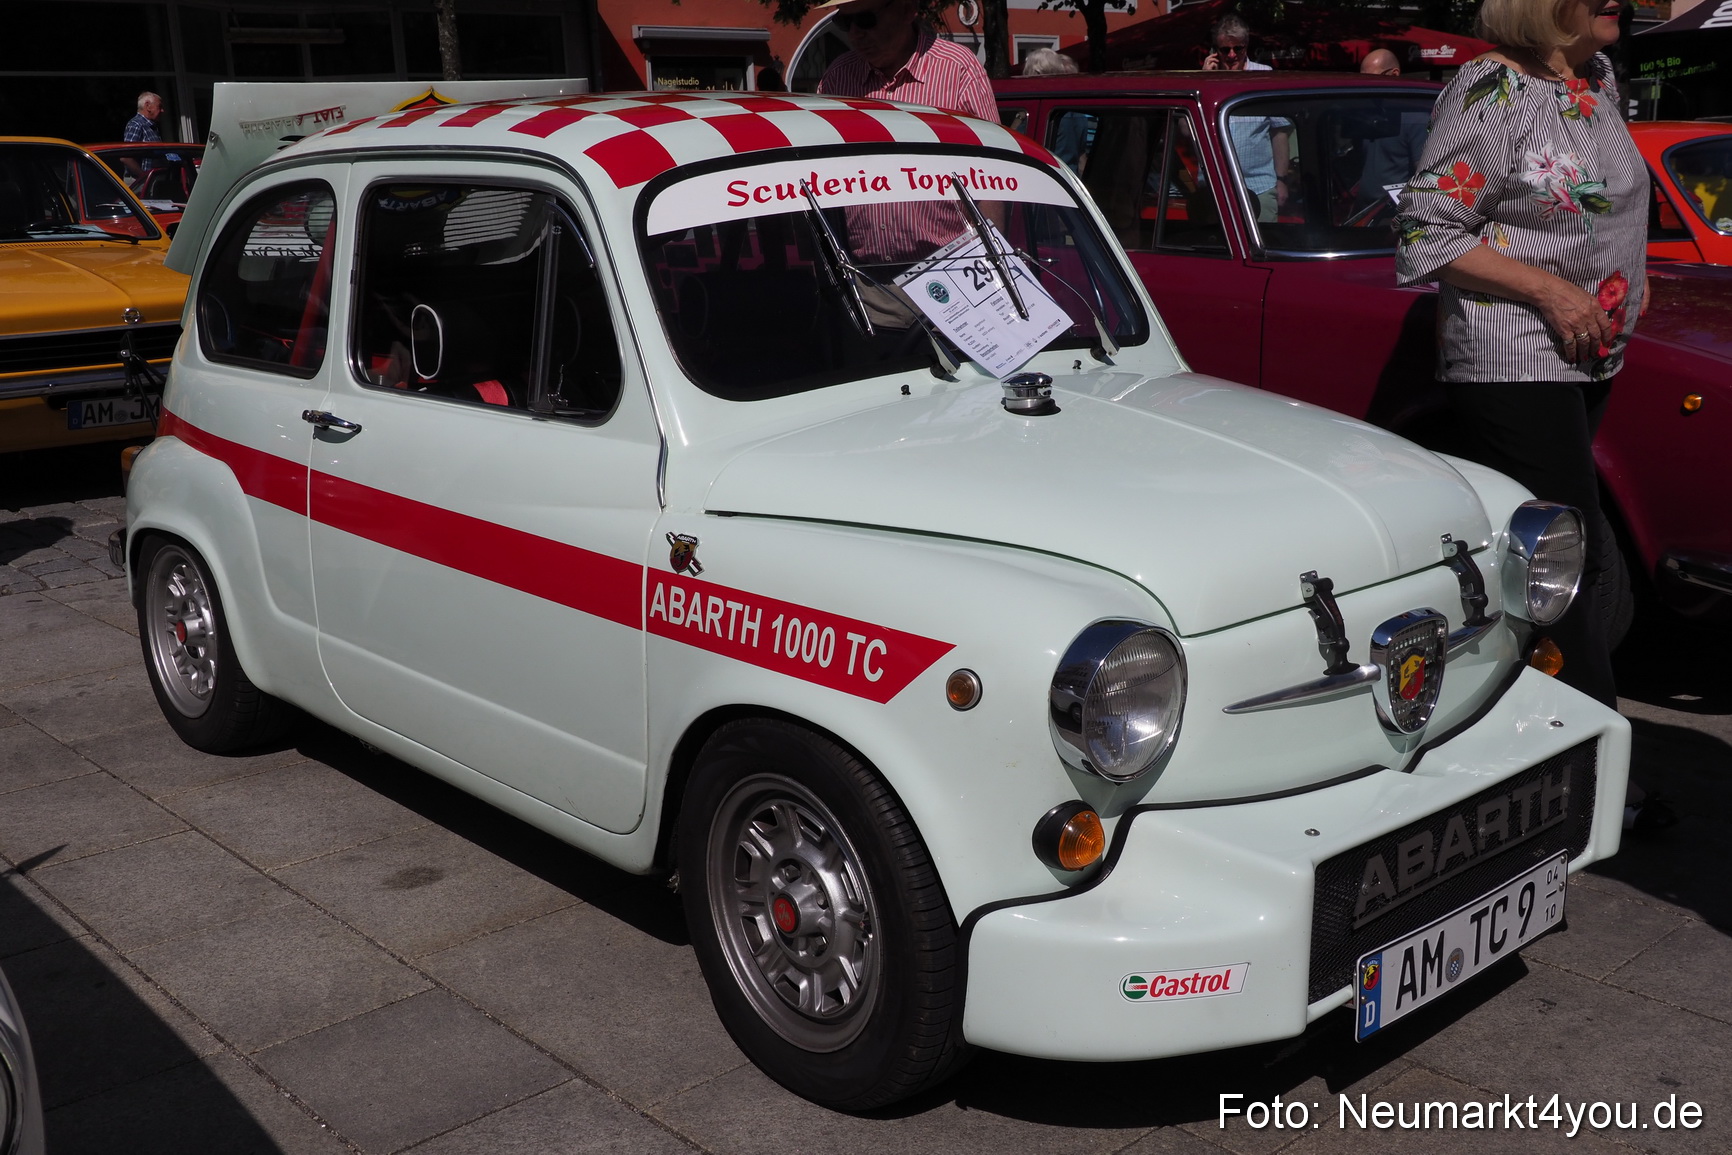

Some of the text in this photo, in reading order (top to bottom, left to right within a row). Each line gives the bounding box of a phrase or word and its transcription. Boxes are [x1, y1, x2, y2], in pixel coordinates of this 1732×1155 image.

[1639, 57, 1681, 72] 100 % Bio
[657, 77, 700, 88] Nagelstudio
[313, 106, 344, 124] FIAT
[727, 169, 891, 207] Scuderia
[82, 401, 113, 425] AM
[677, 535, 697, 544] ABARTH
[649, 582, 888, 683] ABARTH 1000 TC
[1353, 765, 1571, 920] ABARTH
[1546, 865, 1559, 885] 04
[1545, 903, 1556, 923] 10
[1395, 881, 1536, 1011] AM TC 9
[1149, 969, 1232, 998] Castrol
[1364, 1000, 1376, 1028] D
